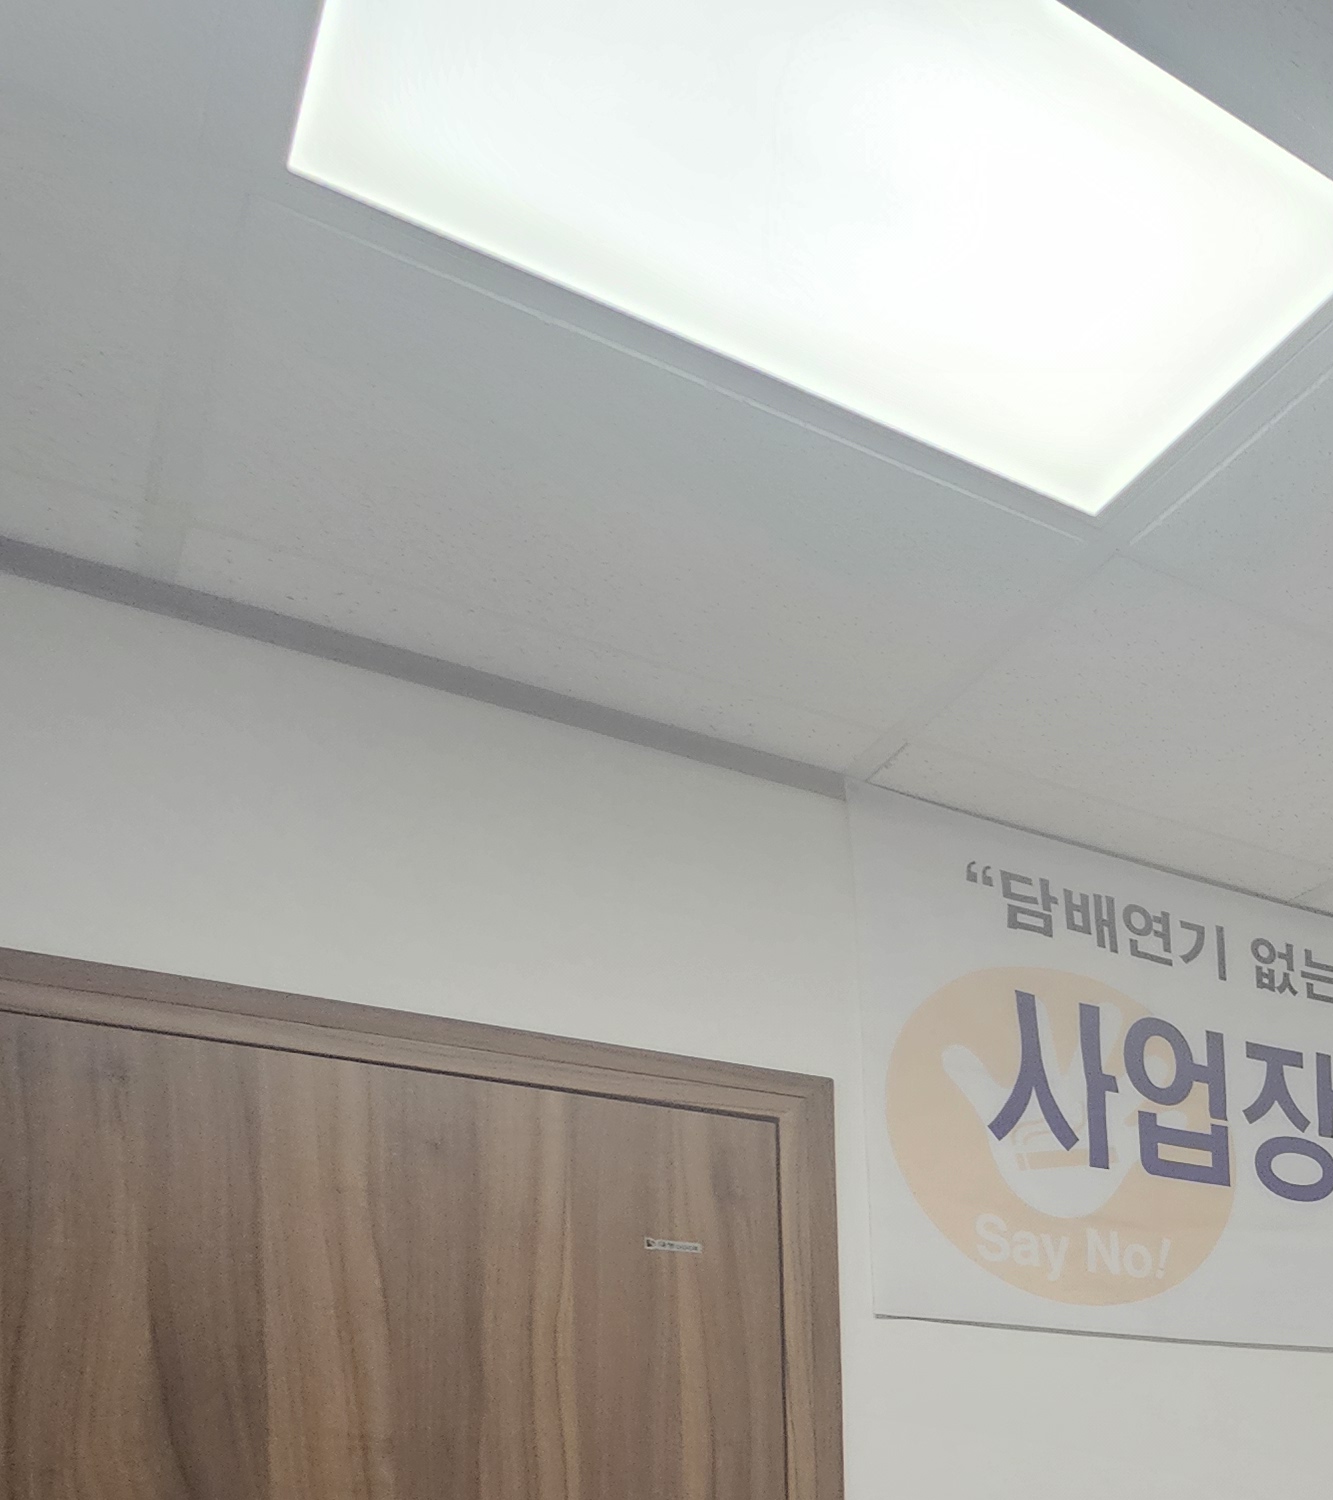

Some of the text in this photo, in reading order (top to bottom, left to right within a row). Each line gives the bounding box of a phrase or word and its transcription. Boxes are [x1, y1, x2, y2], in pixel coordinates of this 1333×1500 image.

[965, 861, 1228, 982] “담배연기
[975, 1212, 1172, 1282] Say No!
